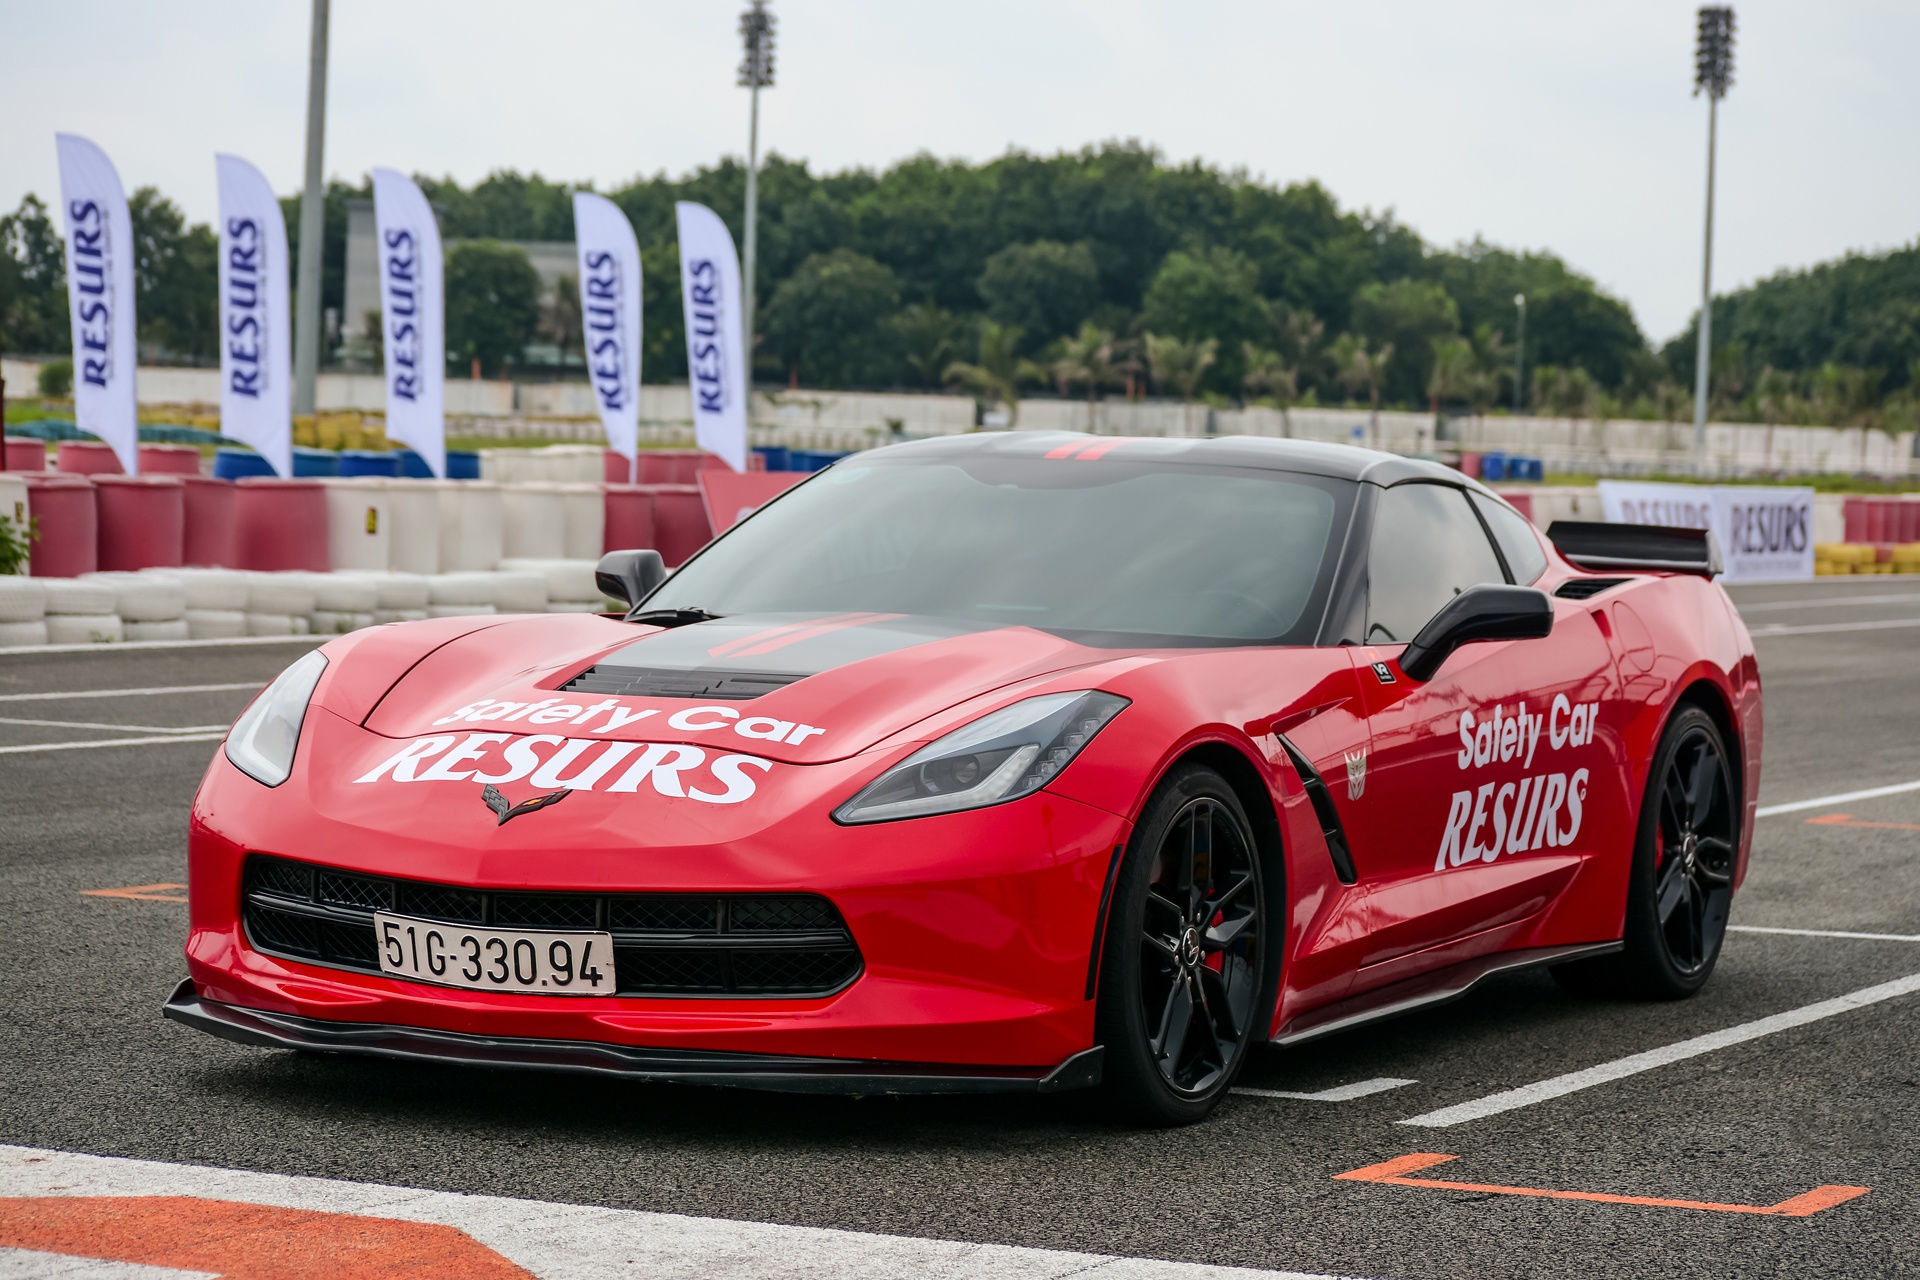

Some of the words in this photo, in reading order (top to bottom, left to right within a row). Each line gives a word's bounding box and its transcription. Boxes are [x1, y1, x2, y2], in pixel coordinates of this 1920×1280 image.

[71, 199, 107, 389] RESURS
[229, 217, 260, 398] RESURS
[385, 228, 416, 401] RESURS
[586, 252, 622, 410] RESURS
[691, 260, 722, 412] RESURS
[1732, 505, 1808, 554] RESURS
[352, 732, 774, 805] RESURS
[432, 696, 662, 734] Safety
[667, 705, 827, 747] Car
[1457, 700, 1544, 770] Safety
[1549, 692, 1600, 752] Car
[382, 921, 604, 988] 51G-330.94
